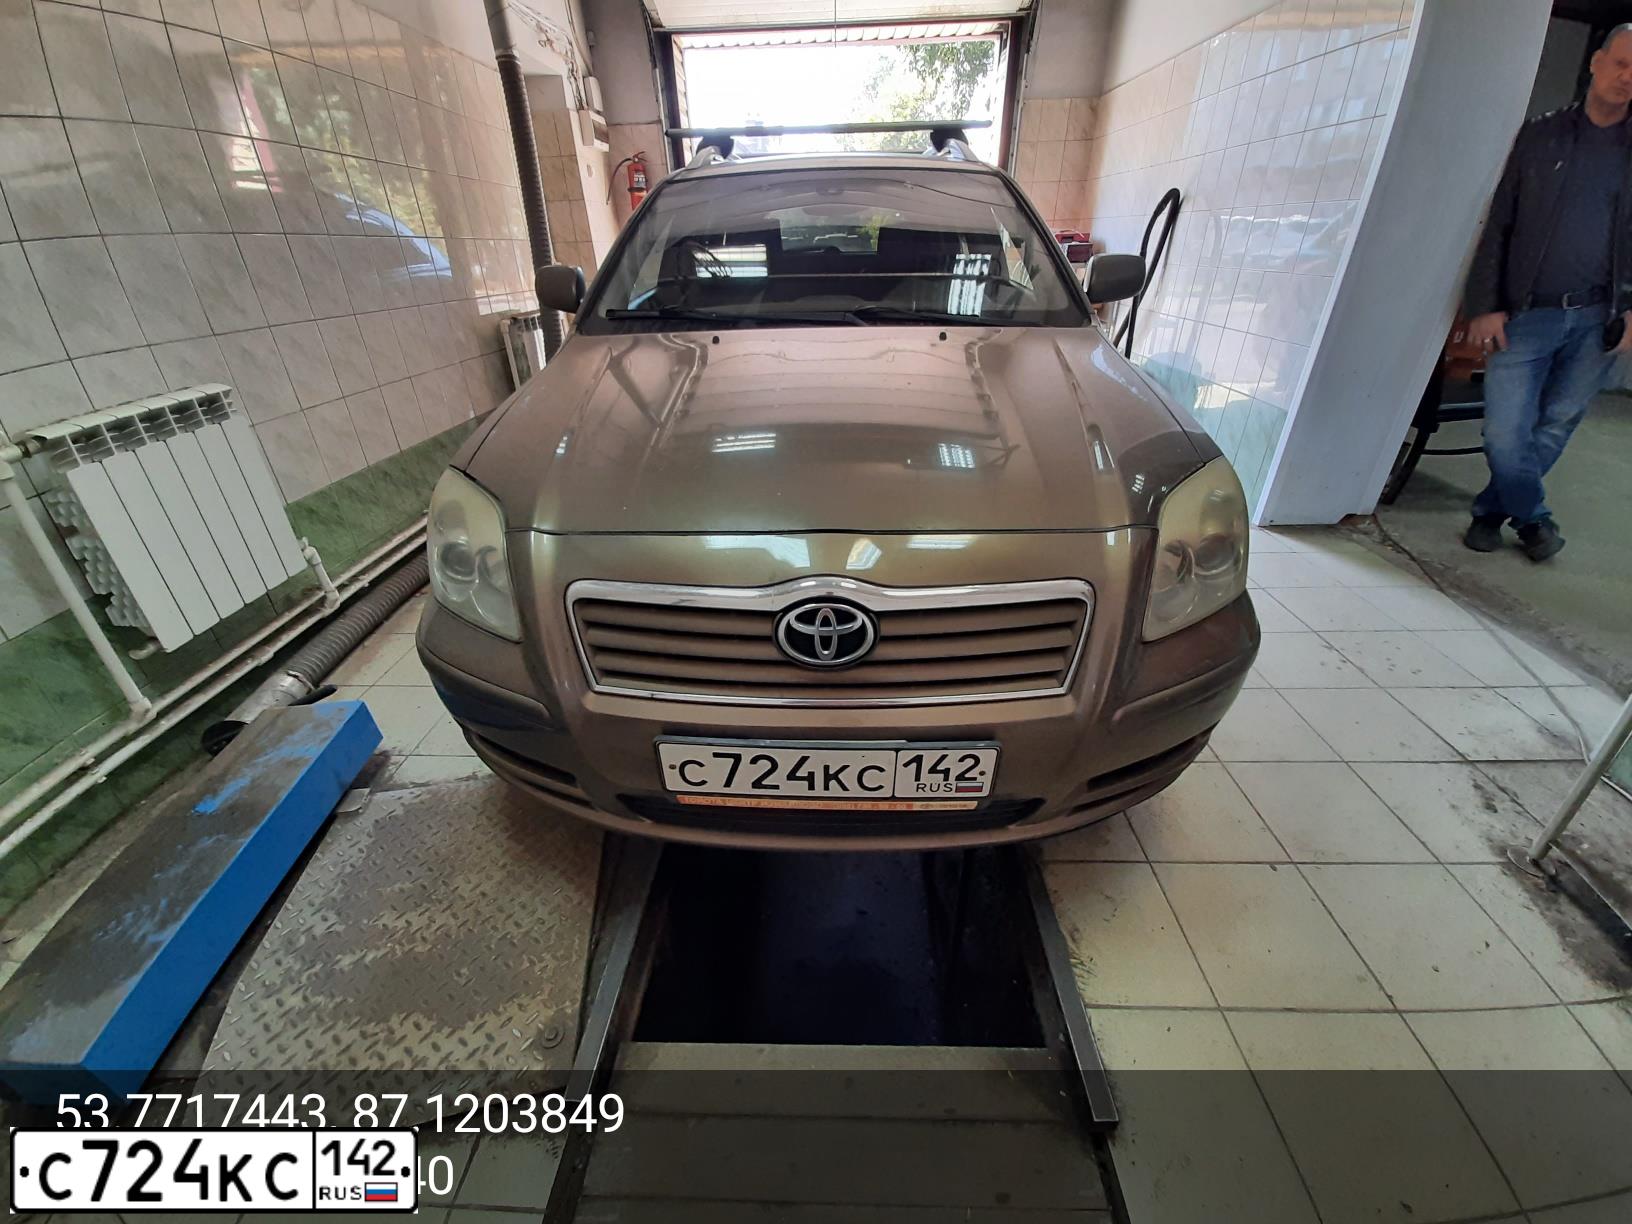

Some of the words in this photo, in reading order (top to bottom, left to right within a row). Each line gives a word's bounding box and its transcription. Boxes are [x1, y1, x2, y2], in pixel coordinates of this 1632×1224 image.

[678, 751, 887, 792] С724КС
[902, 753, 982, 783] 142
[915, 782, 954, 793] RUS
